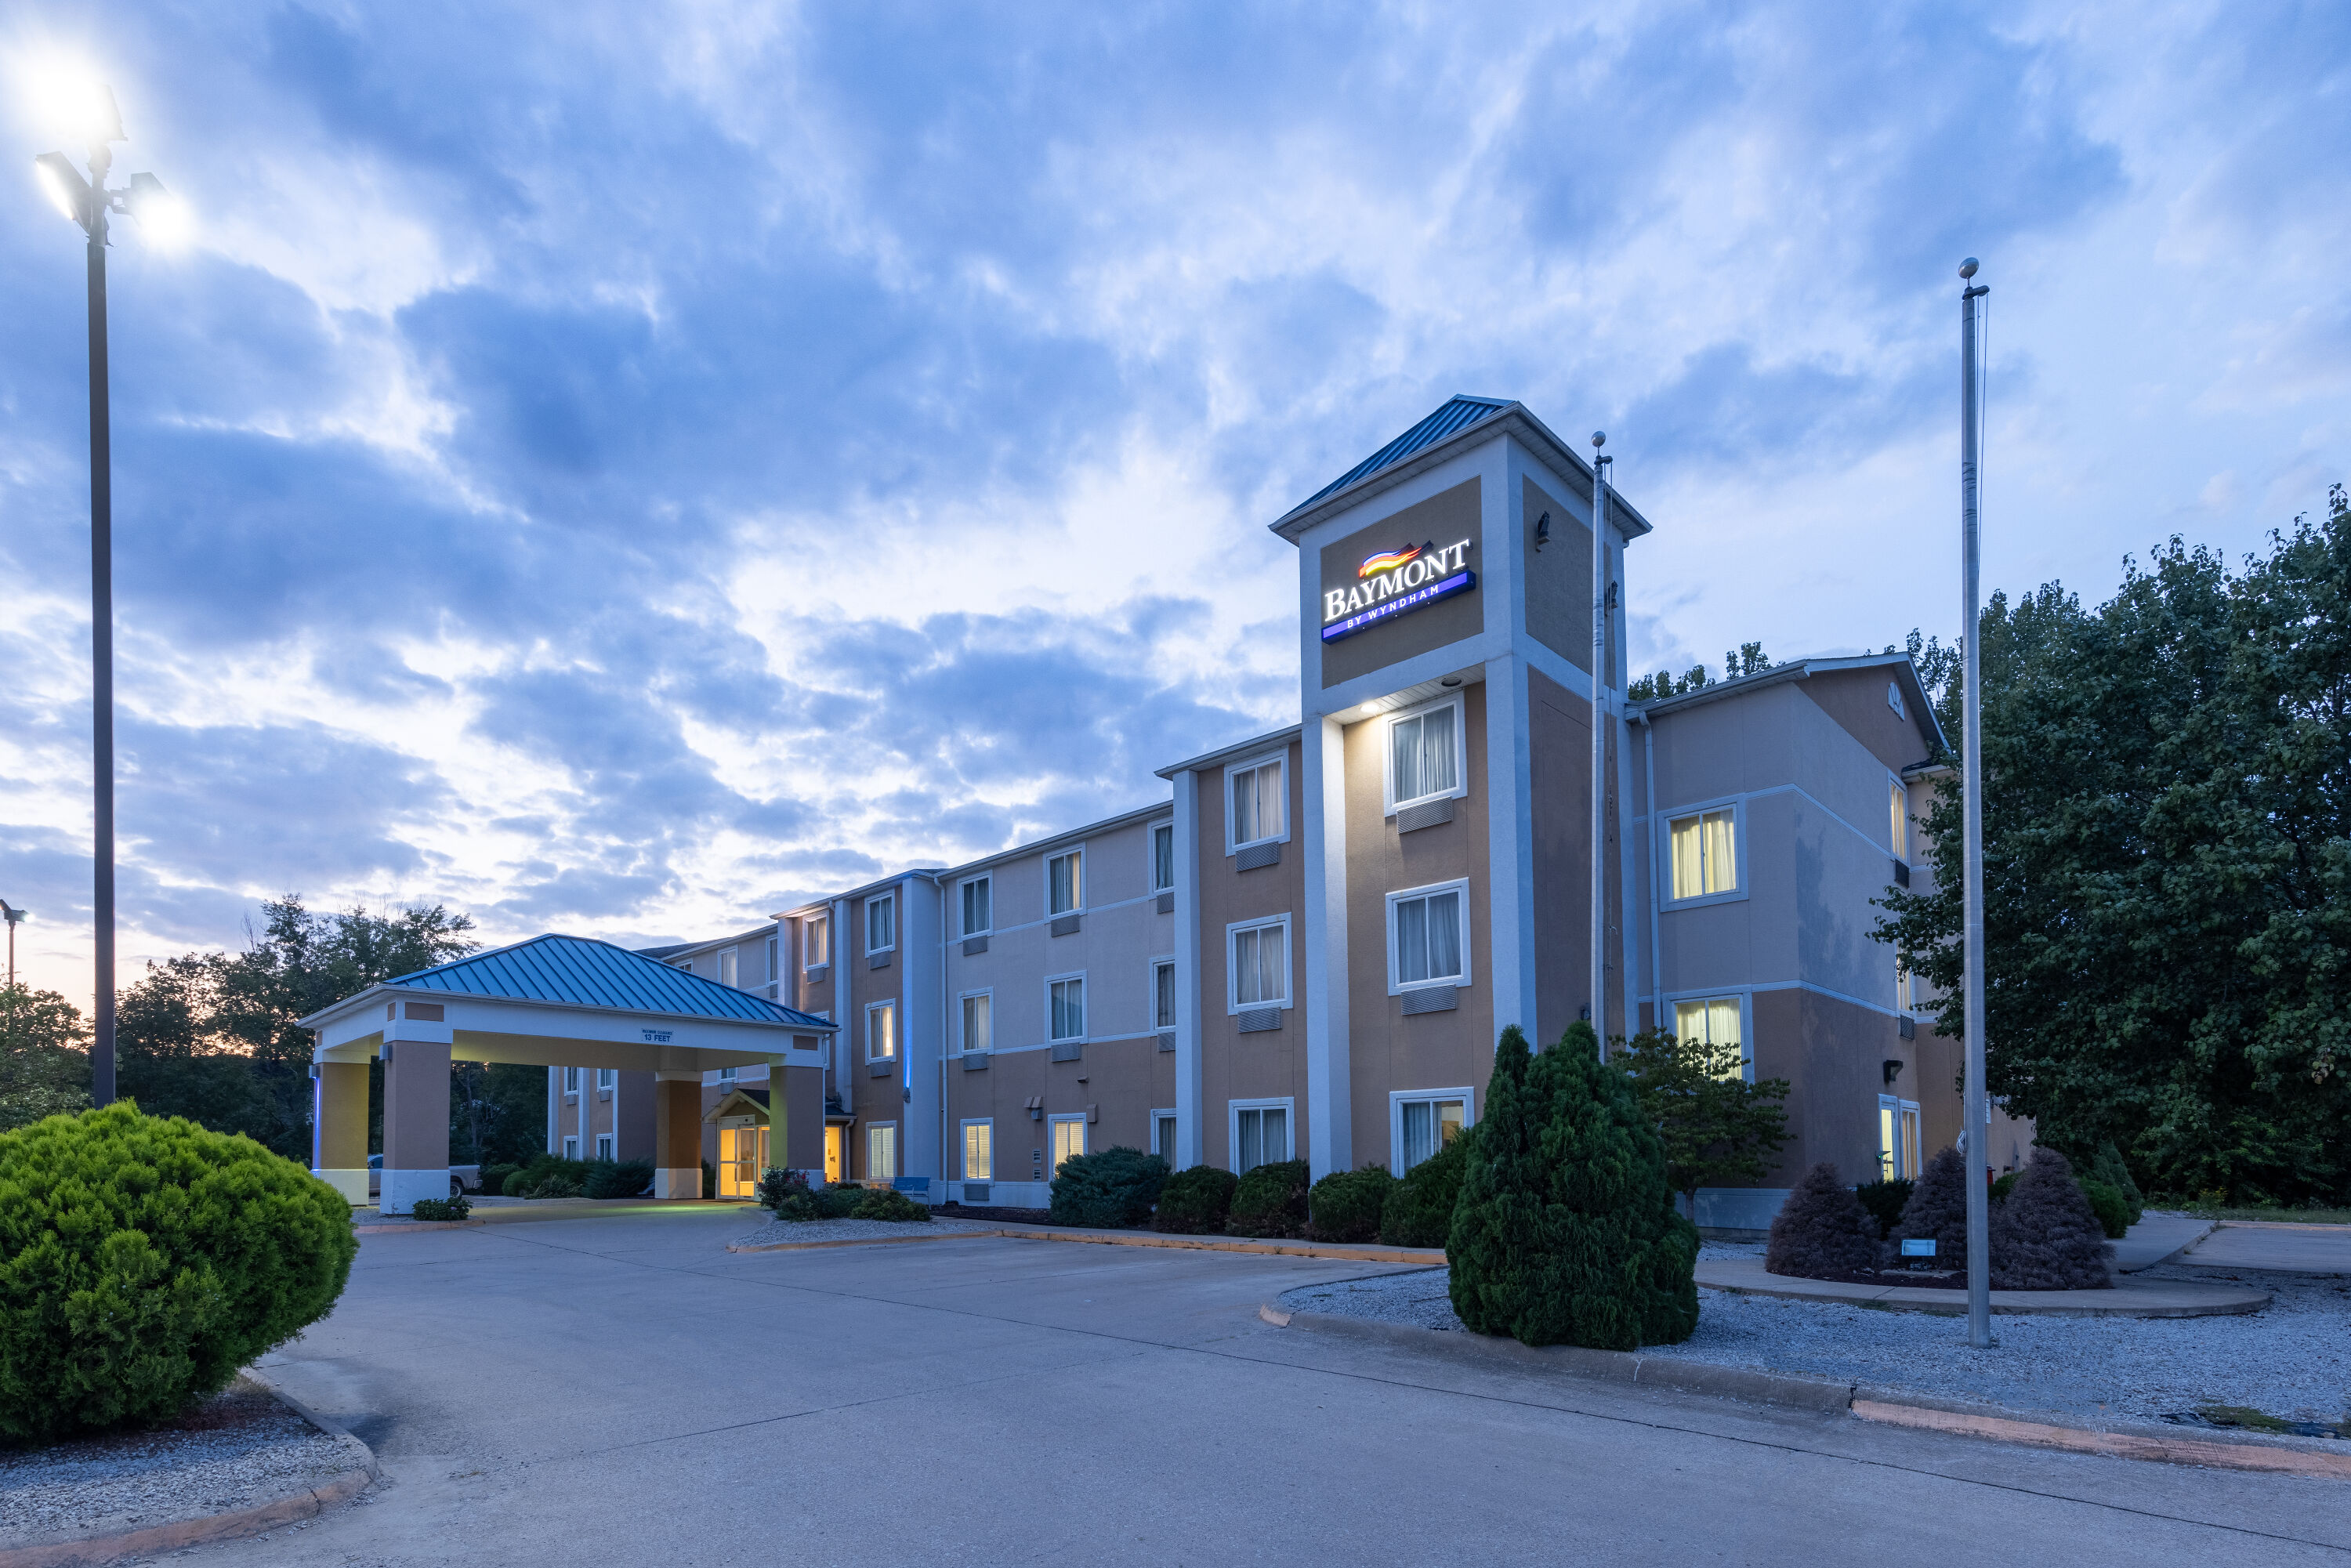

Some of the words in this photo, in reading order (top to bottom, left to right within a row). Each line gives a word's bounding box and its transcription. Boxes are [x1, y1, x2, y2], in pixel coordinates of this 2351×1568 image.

[1324, 538, 1470, 621] BAYMONT
[1347, 616, 1363, 628] BY
[1368, 585, 1439, 621] WYNDHAM
